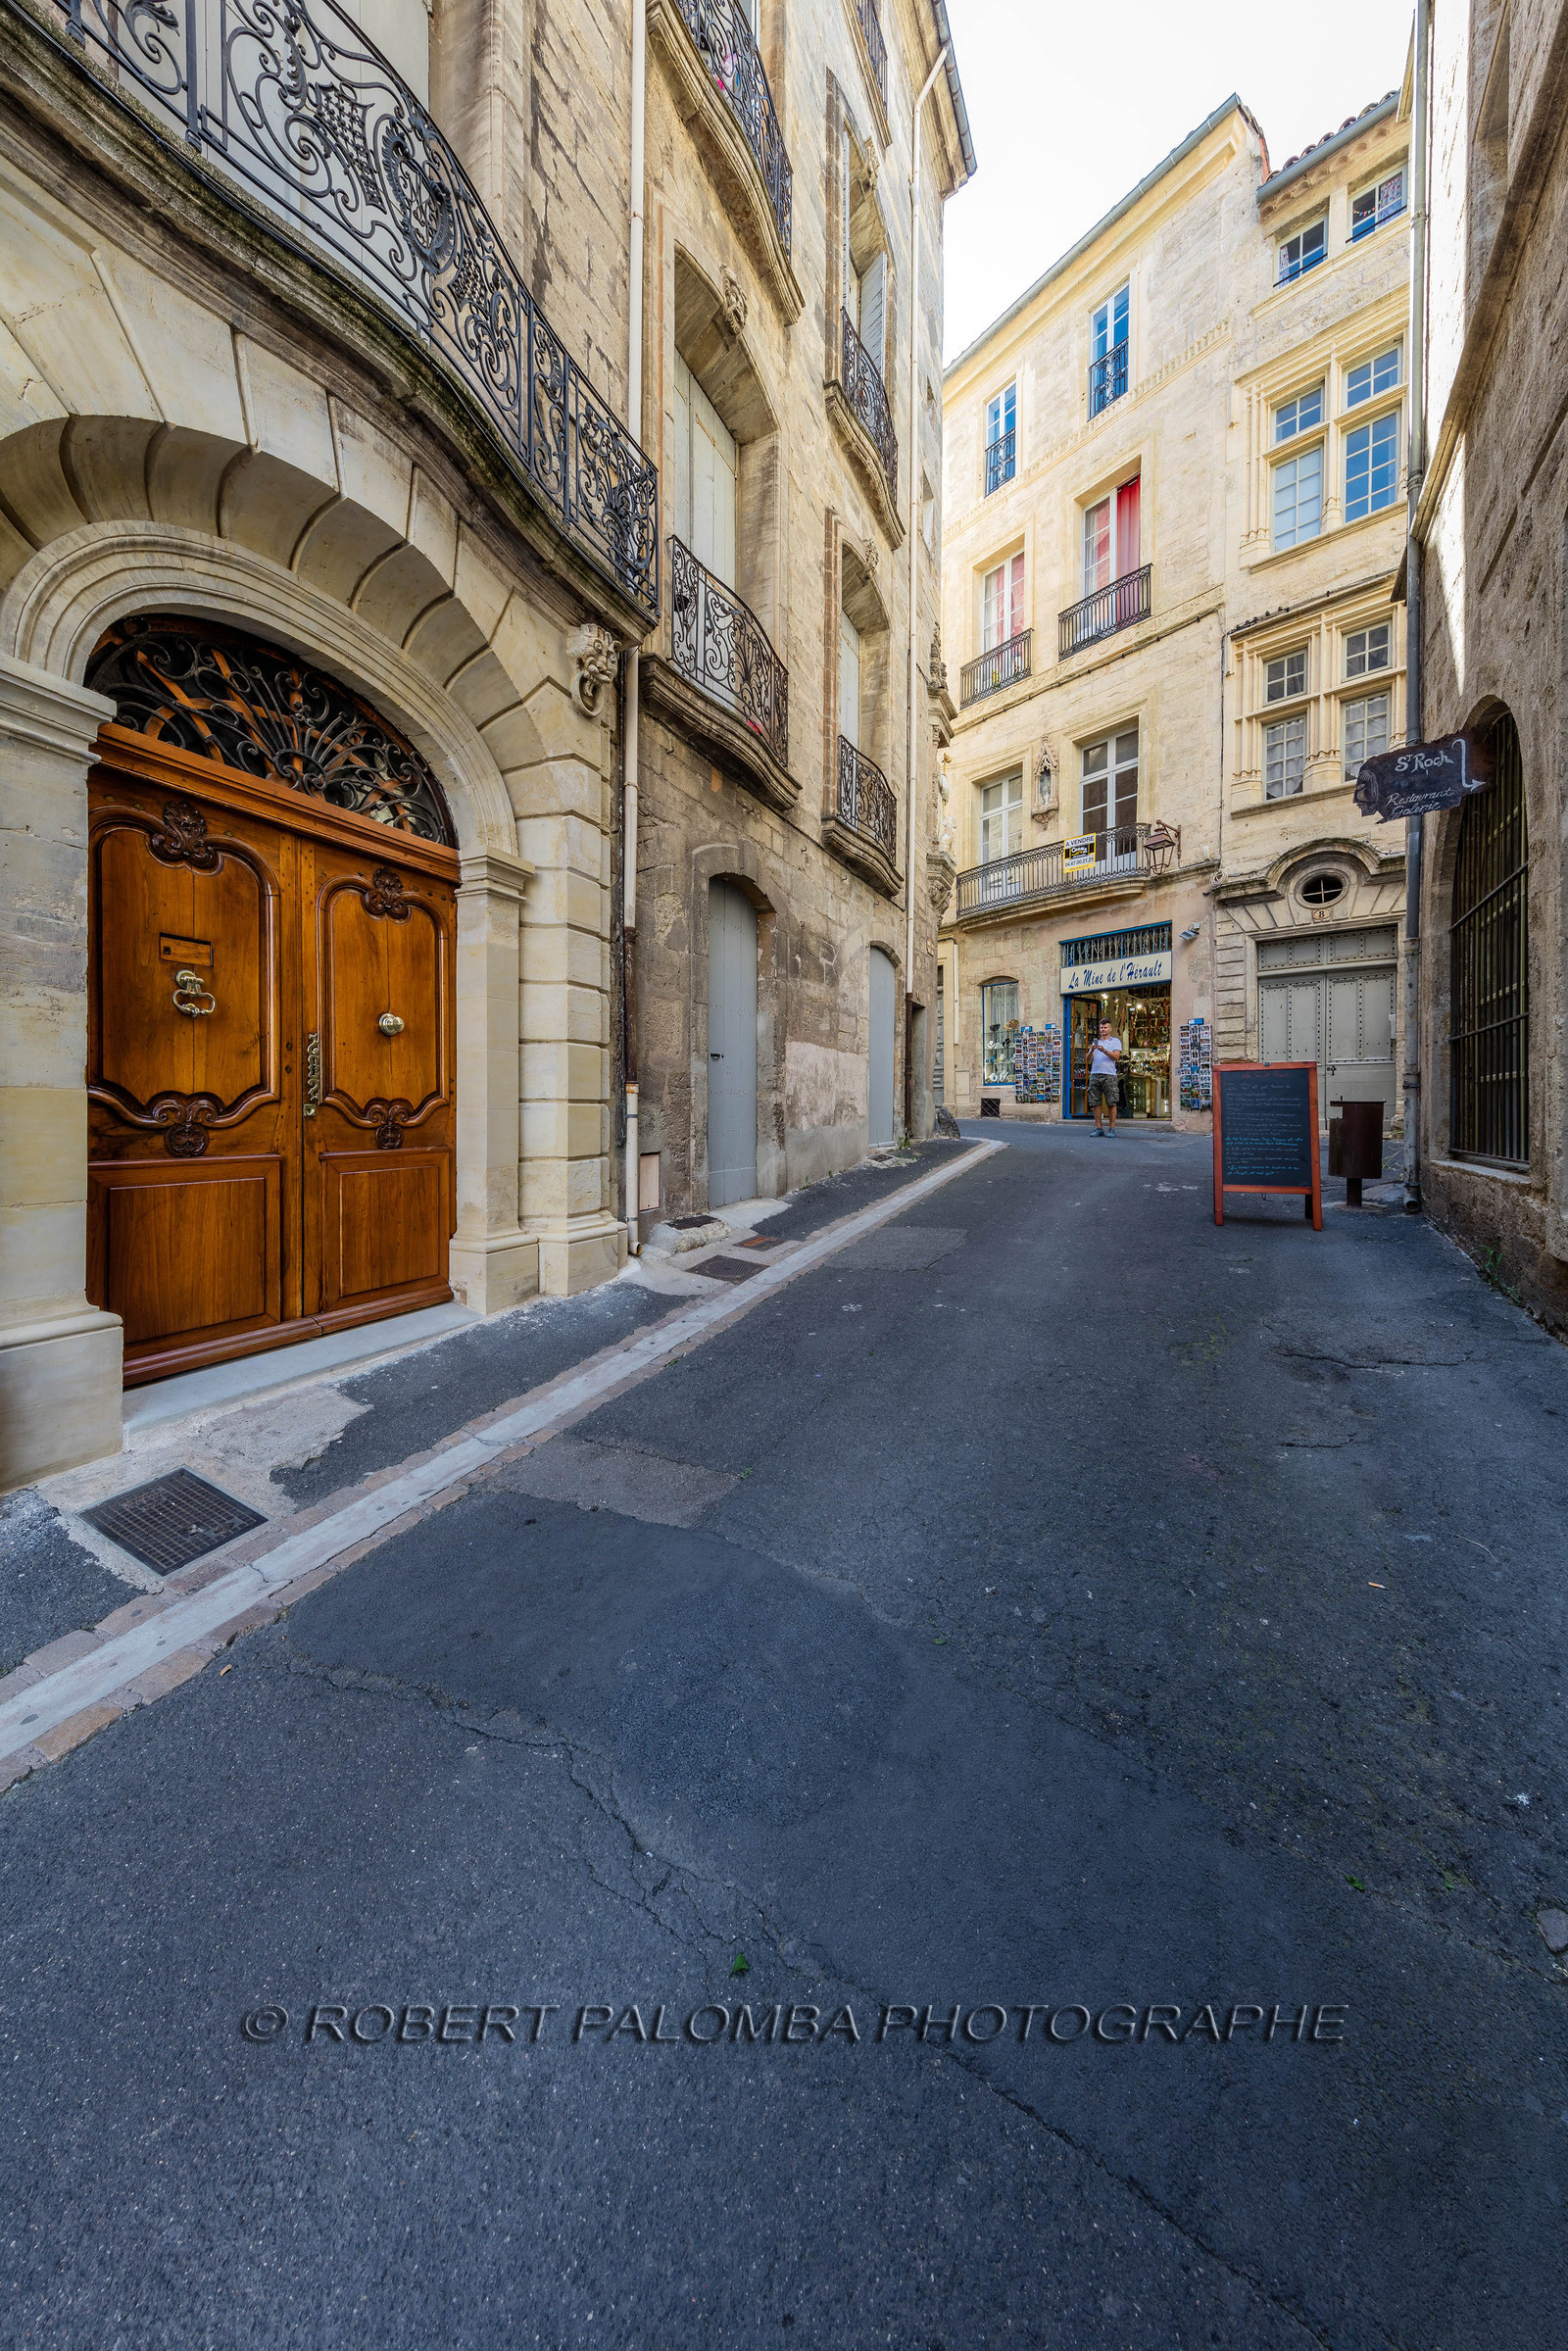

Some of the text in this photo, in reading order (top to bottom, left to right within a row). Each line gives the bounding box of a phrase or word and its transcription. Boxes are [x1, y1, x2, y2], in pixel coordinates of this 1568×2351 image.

[1411, 750, 1454, 773] Roch
[1385, 787, 1454, 808] Restaurant
[1392, 800, 1442, 819] Galerie
[1071, 836, 1094, 845] VENDRE
[1068, 959, 1162, 990] La Mine de l'Hérault
